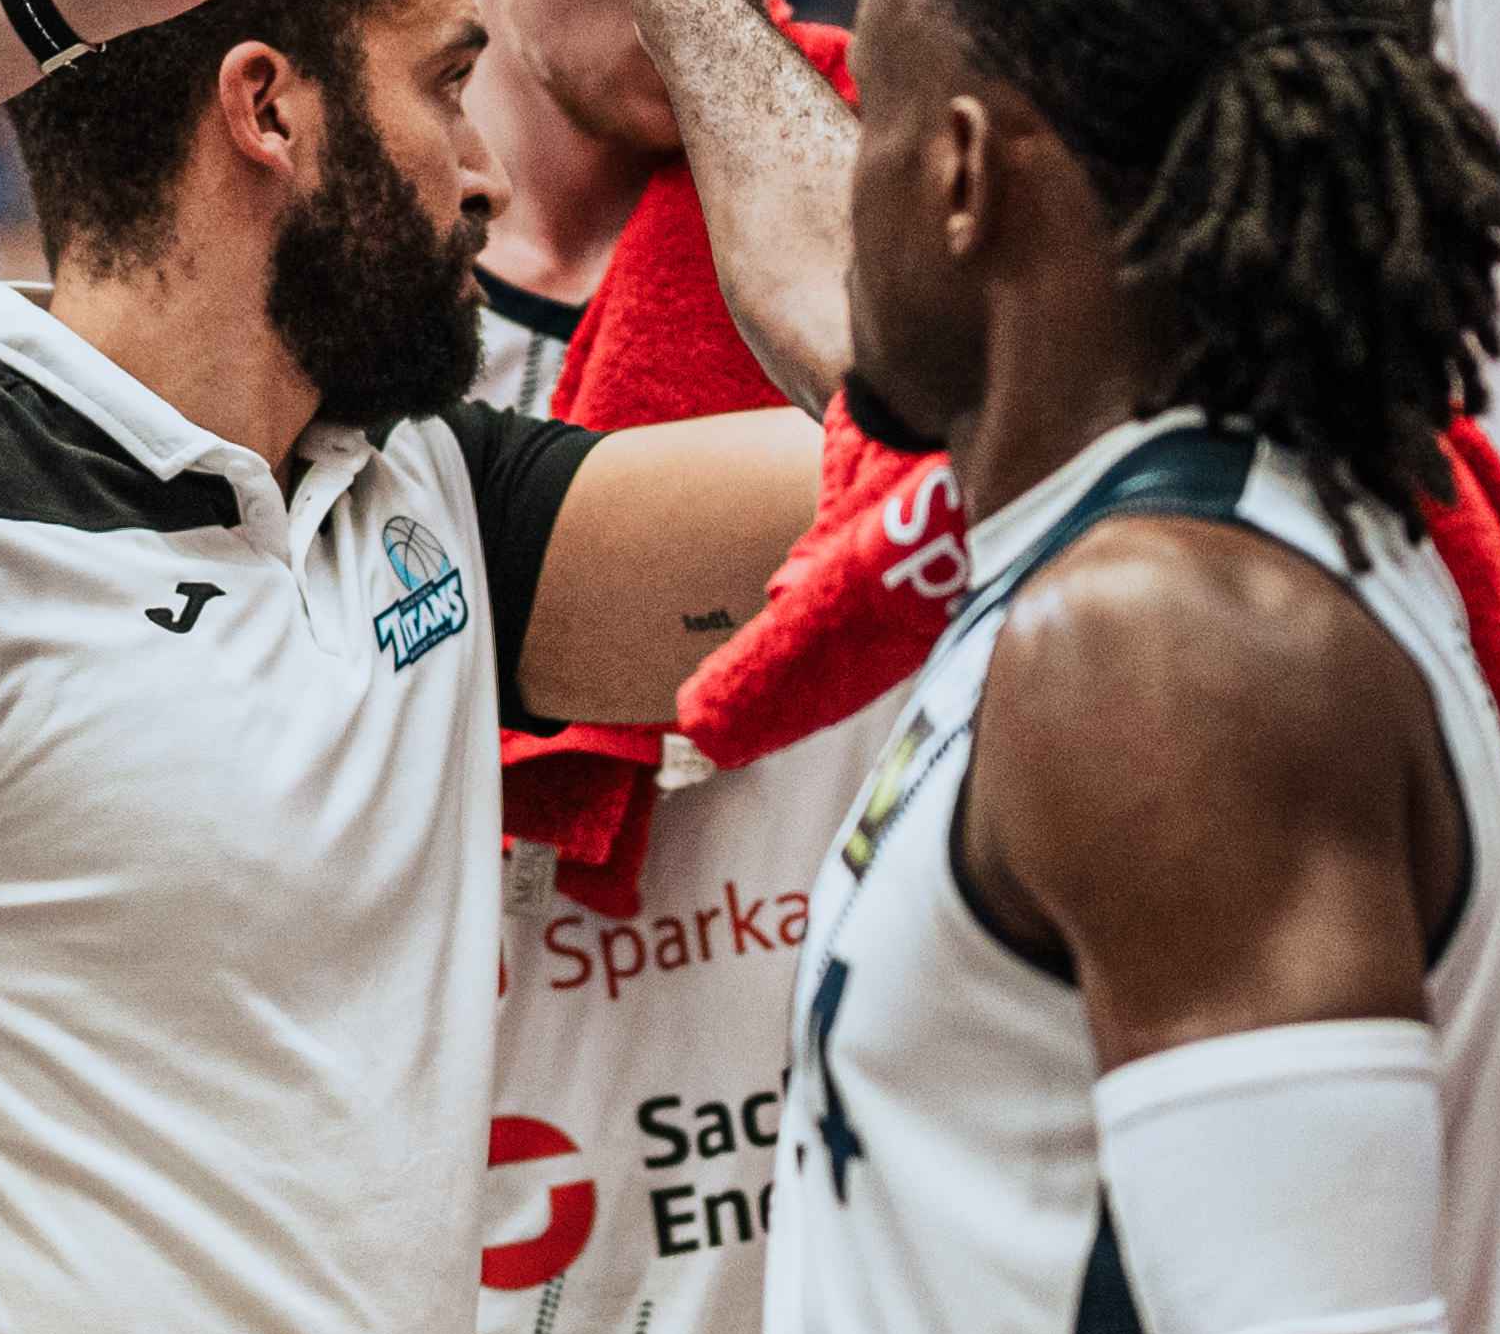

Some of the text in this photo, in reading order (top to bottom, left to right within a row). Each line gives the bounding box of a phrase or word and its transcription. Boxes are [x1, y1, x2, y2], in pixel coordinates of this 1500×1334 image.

[882, 465, 970, 617] Sp
[376, 574, 466, 666] TITANS
[635, 1067, 792, 1170] Sac
